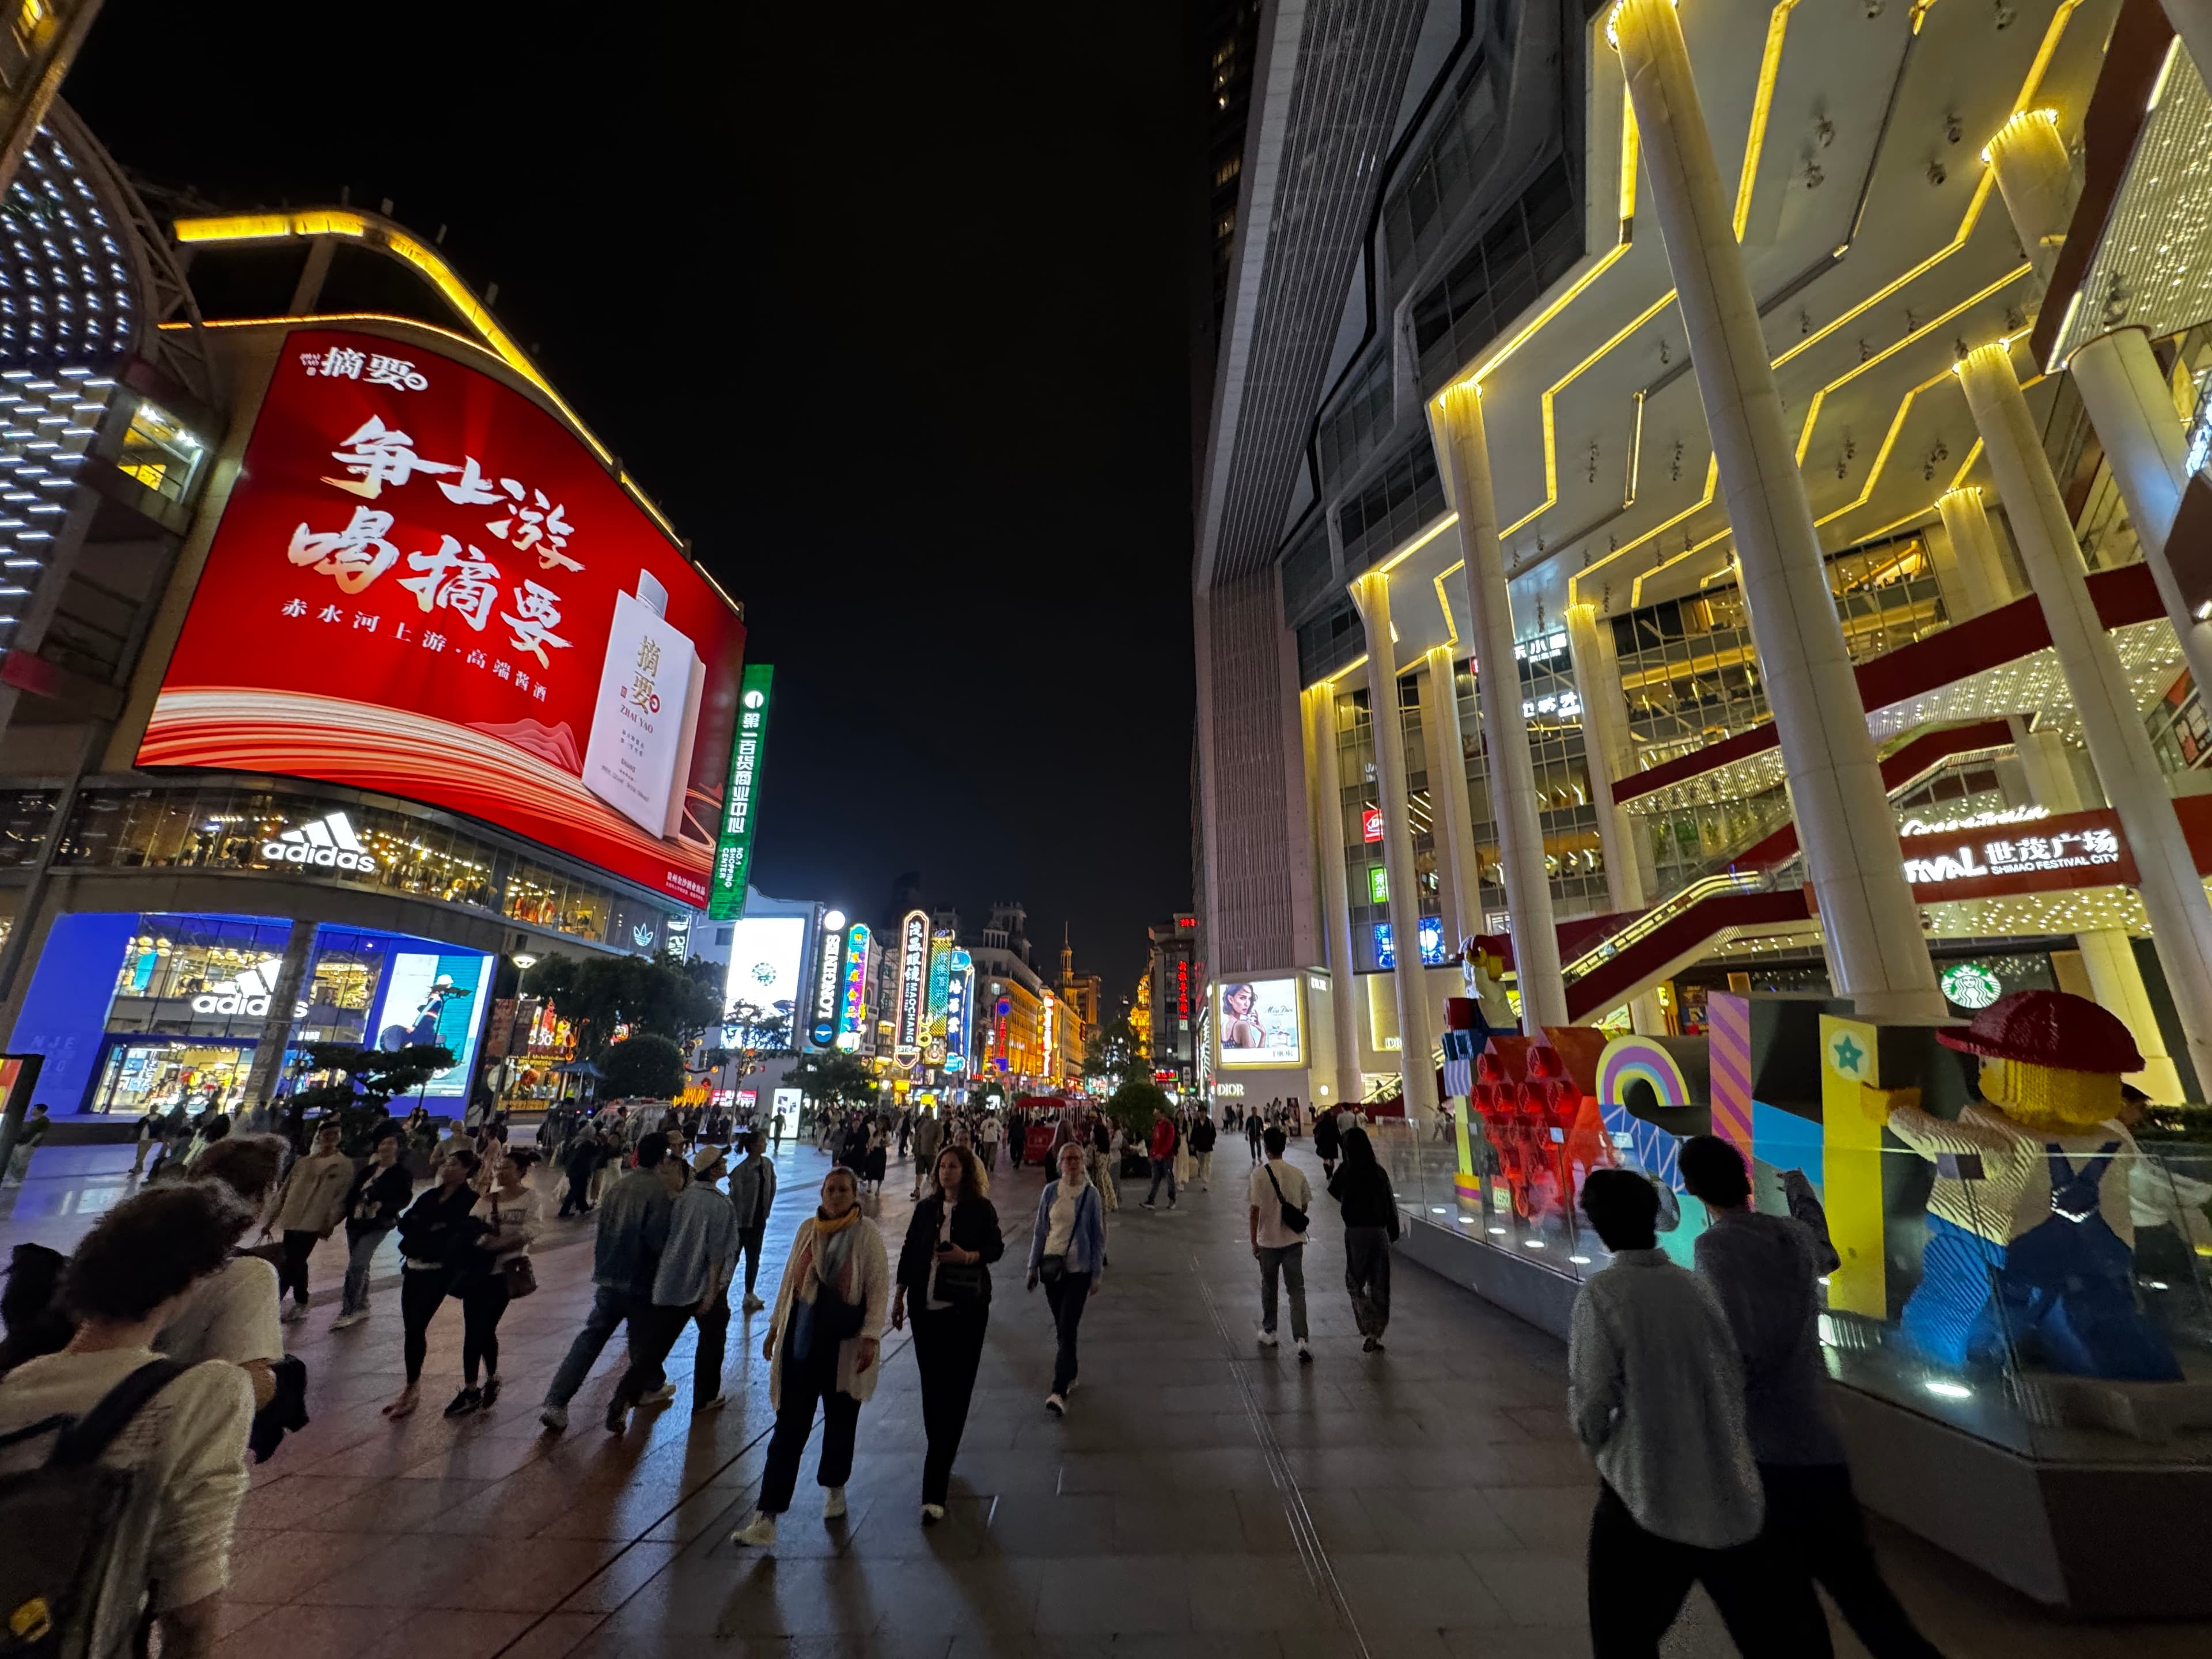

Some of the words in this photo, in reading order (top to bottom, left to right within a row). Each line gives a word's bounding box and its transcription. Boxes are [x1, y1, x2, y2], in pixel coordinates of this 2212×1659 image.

[320, 347, 428, 391] 摘要
[288, 505, 574, 669] 喝摘要
[620, 704, 638, 724] ZHAI
[639, 717, 654, 734] YAO
[728, 712, 761, 834] 第一百货商业中心
[263, 842, 376, 873] adidas
[718, 847, 730, 880] CENTER
[735, 847, 744, 866] NO.1
[1985, 828, 2119, 865] 世茂广场
[1991, 862, 2035, 876] SHIMAO
[2035, 856, 2090, 870] FESTIVAL
[2090, 852, 2119, 865] CITY
[724, 847, 737, 889] SHOPPING
[818, 934, 841, 1019] LONGINES
[192, 992, 309, 1018] adids
[906, 982, 918, 1043] MAOCHANG
[1217, 1083, 1244, 1096] DIOR
